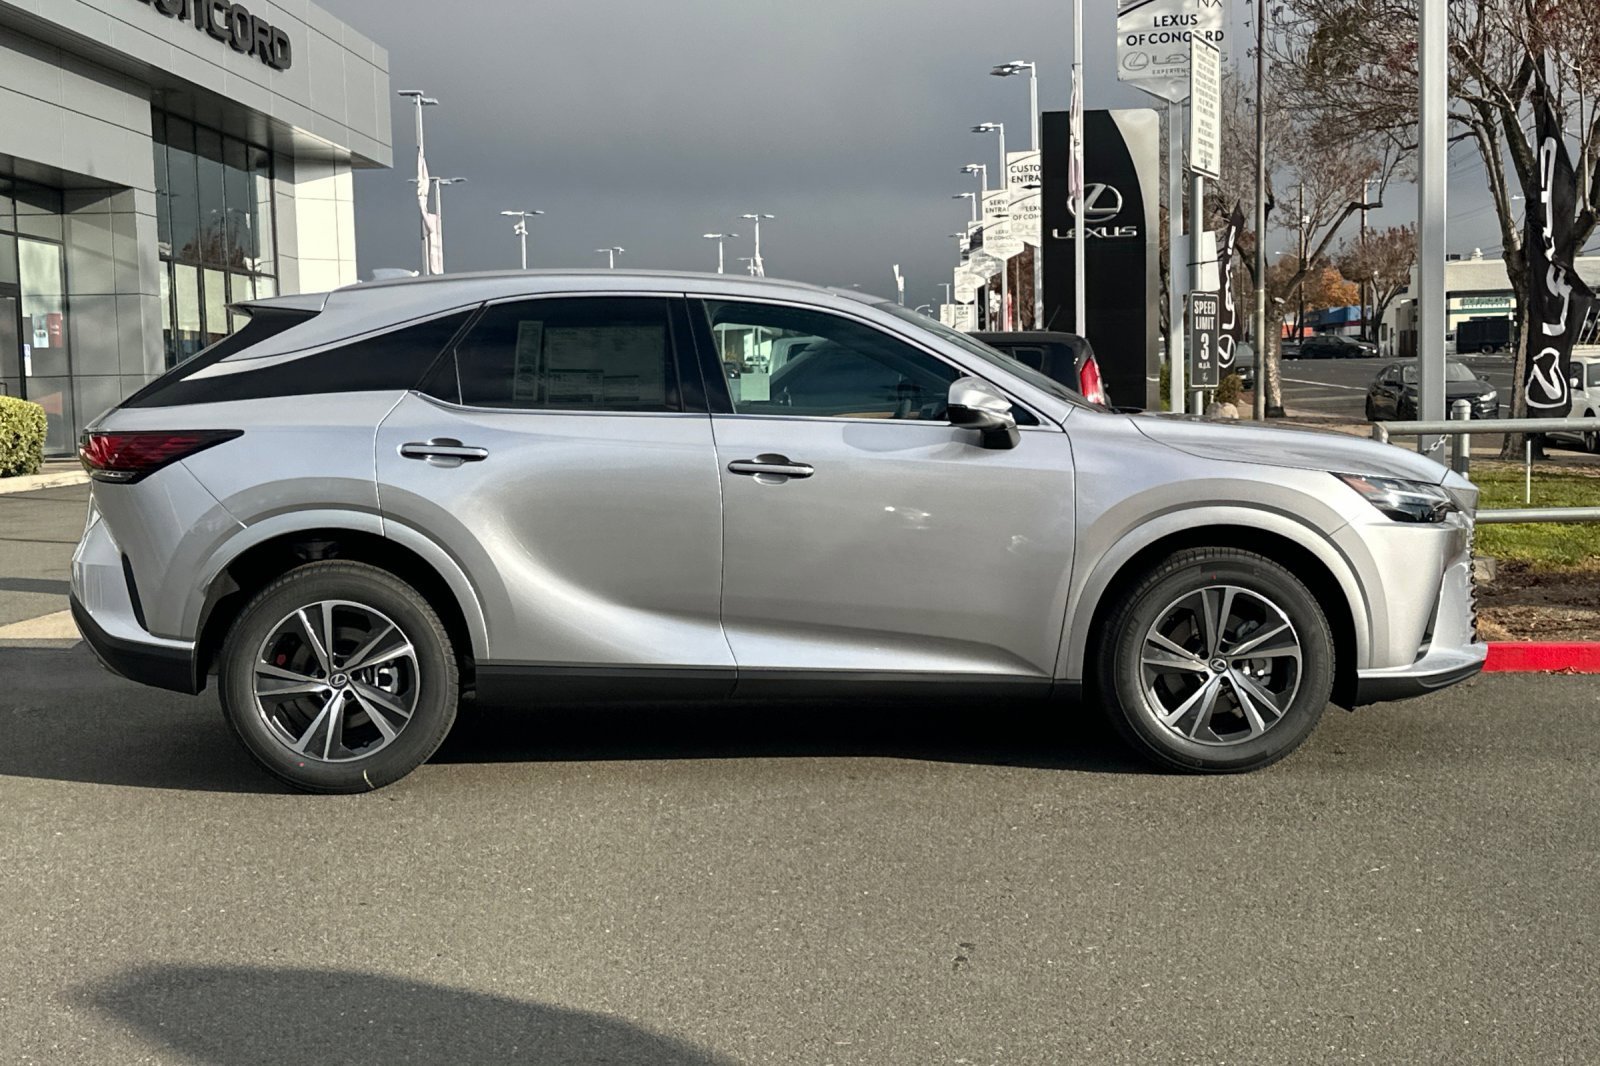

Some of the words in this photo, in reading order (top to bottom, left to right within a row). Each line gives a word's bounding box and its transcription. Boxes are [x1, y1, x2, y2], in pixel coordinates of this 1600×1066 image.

[1153, 14, 1198, 27] LEXUS
[137, 0, 291, 72] NCORD
[1126, 34, 1146, 46] OF
[1148, 30, 1224, 44] CONCRD
[1010, 165, 1041, 173] CUSTO
[1011, 175, 1041, 183] ENTRA
[1052, 226, 1138, 239] LEXUS
[1194, 300, 1216, 315] SPEED
[1195, 316, 1215, 330] LIMIT
[1200, 332, 1210, 360] 3
